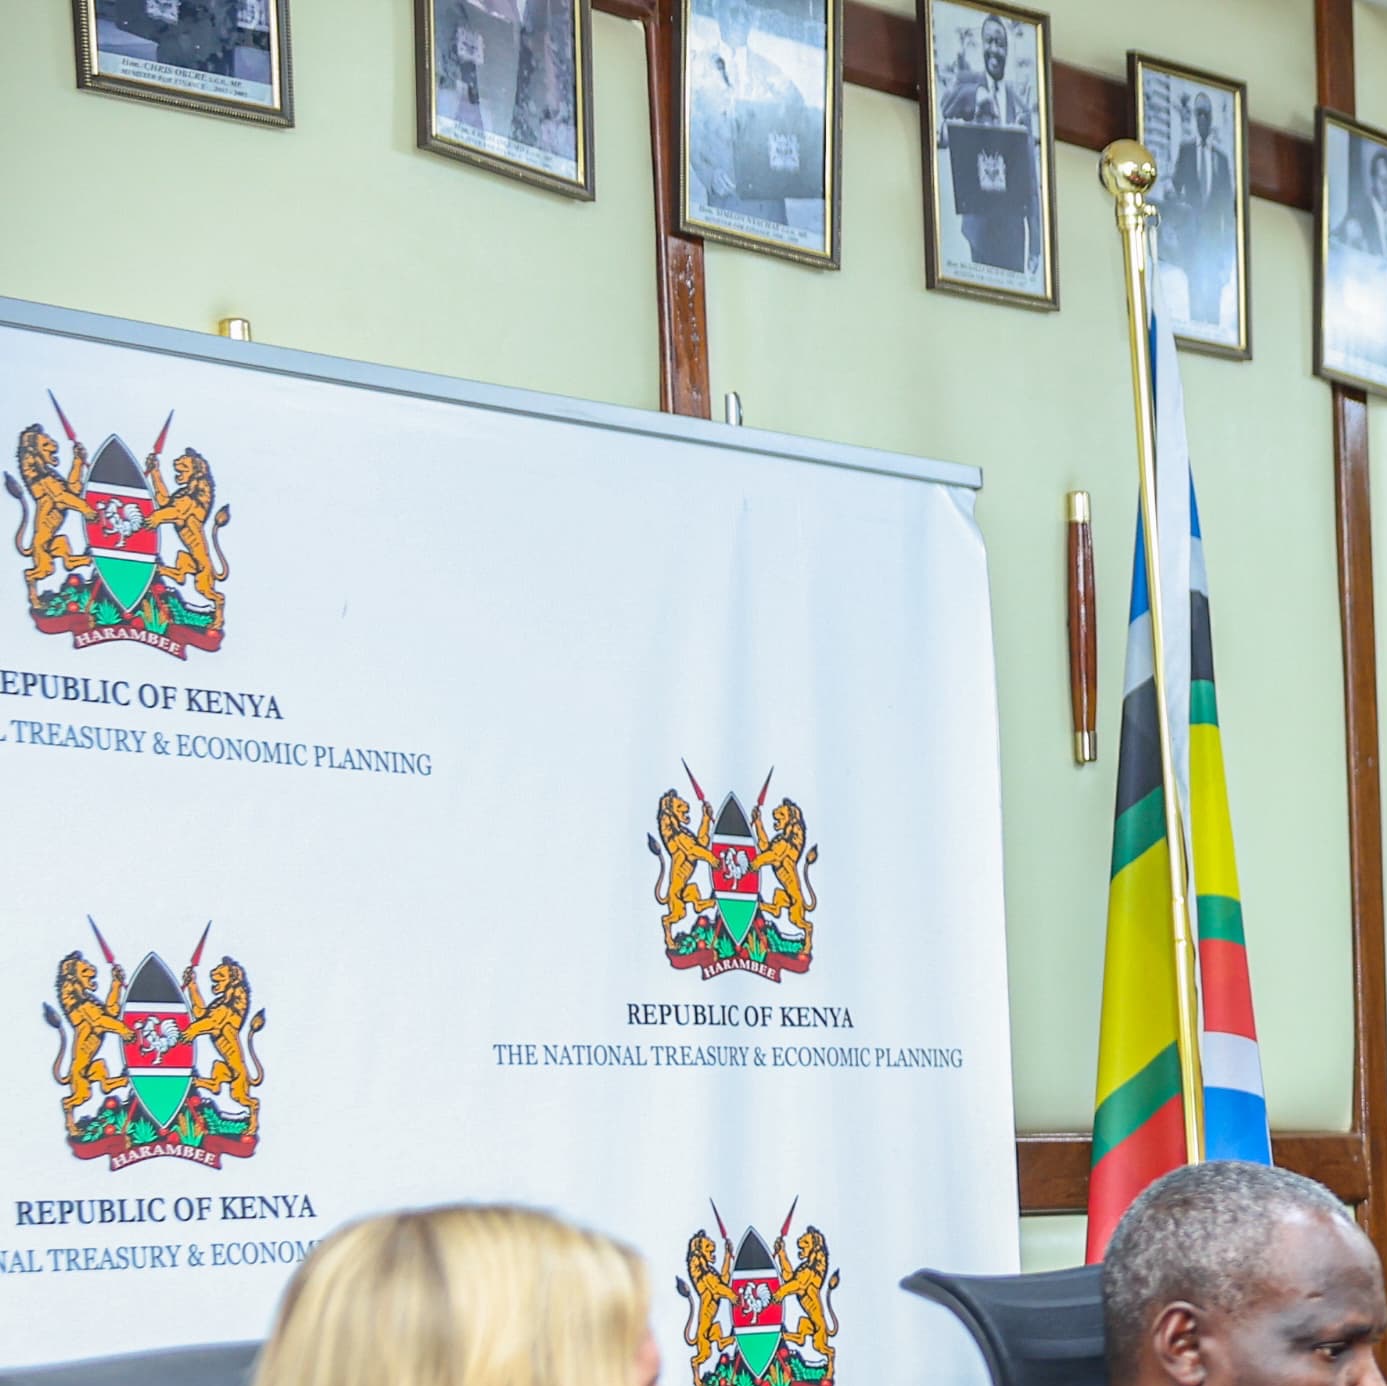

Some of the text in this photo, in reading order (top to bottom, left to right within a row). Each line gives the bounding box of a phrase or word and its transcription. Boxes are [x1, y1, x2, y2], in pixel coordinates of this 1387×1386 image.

[75, 627, 182, 655] HARAMBEE
[0, 669, 284, 720] EPUBLIC OF KENYA
[10, 719, 147, 753] TREASURY
[152, 731, 171, 756] &
[176, 733, 308, 766] ECONOMIC
[312, 745, 433, 776] PLANNING
[703, 958, 777, 979] HARAMBEE
[627, 1002, 854, 1028] REPUBLIC OF KENYA
[493, 1043, 963, 1068] THE NATIONAL TREASURY & ECONOMIC PLANNING
[112, 1144, 217, 1169] HARAMBEE
[15, 1194, 317, 1226] REPUBLIC OF KENYA
[47, 1244, 182, 1273] TREASURY
[187, 1243, 205, 1267] &
[211, 1240, 320, 1266] ECONOM
